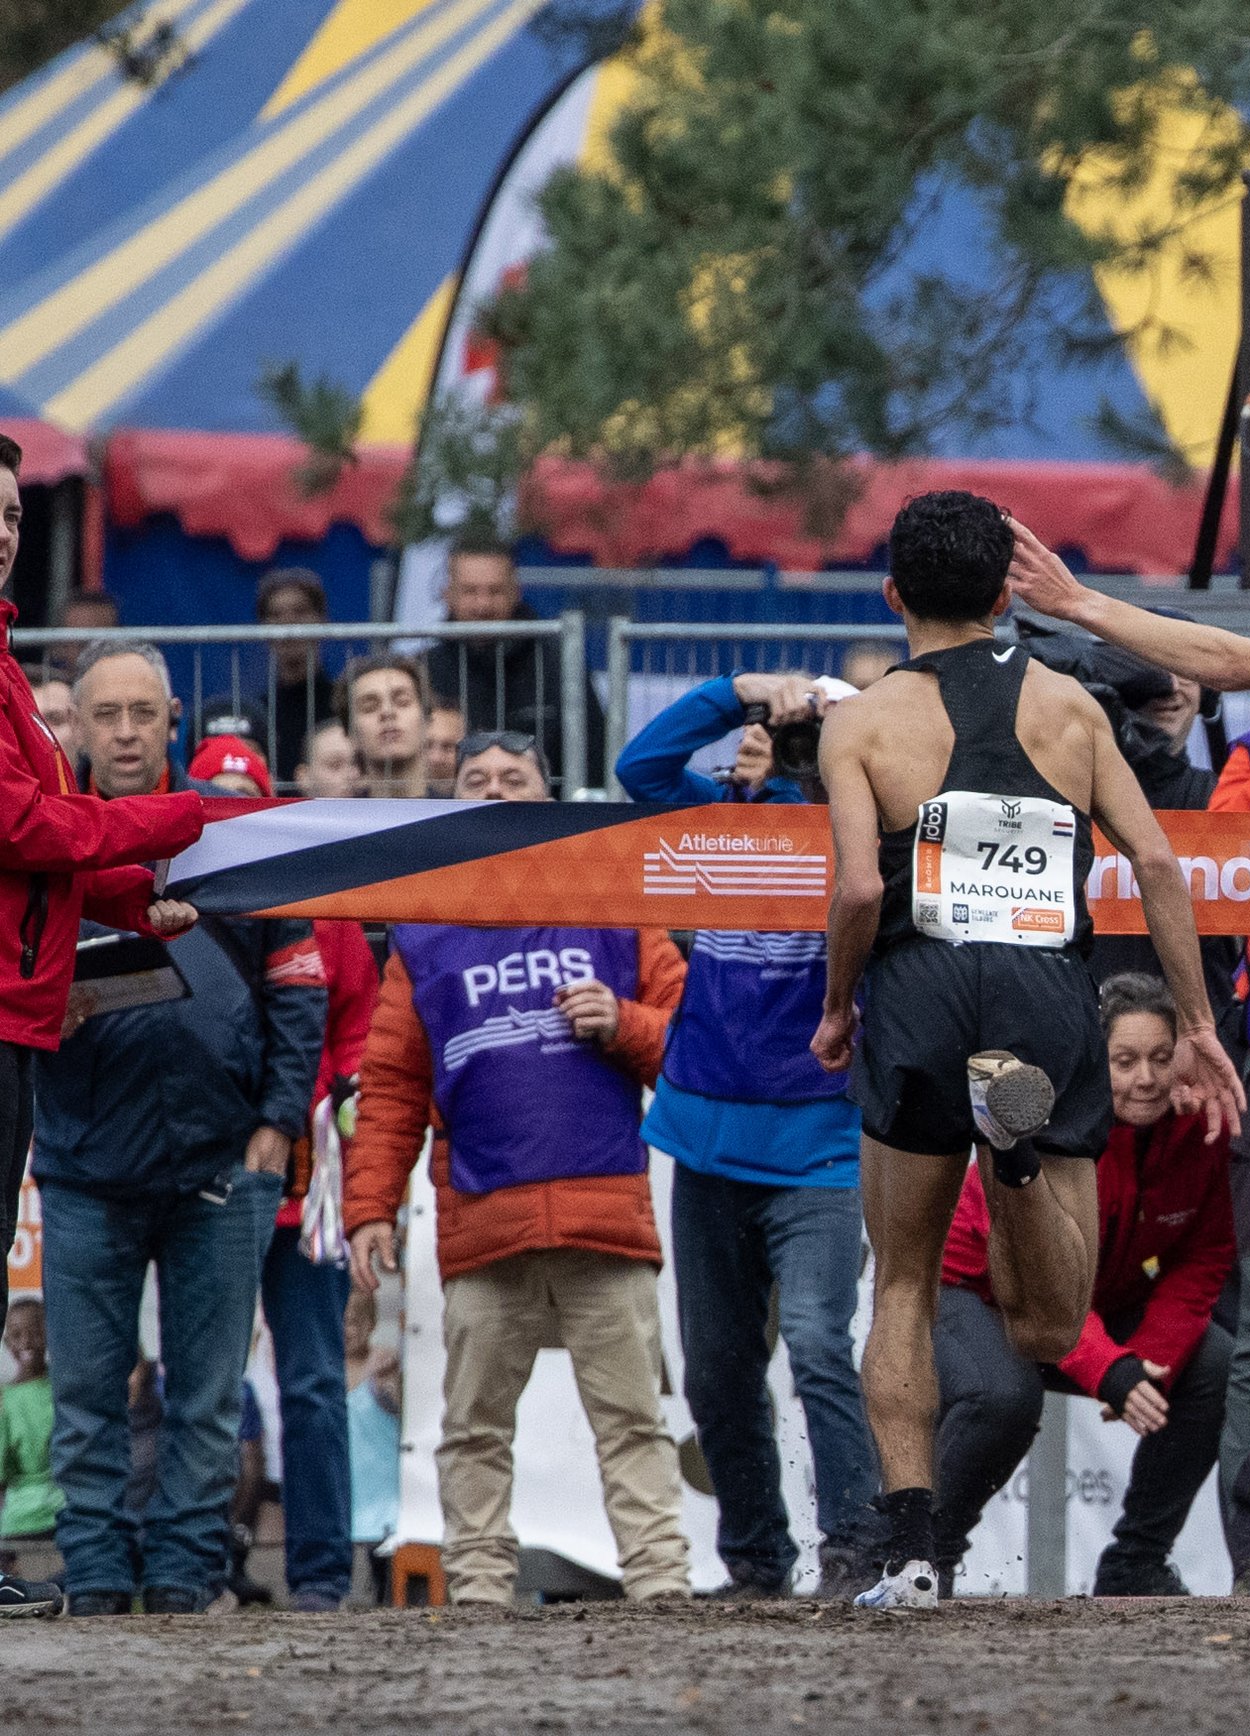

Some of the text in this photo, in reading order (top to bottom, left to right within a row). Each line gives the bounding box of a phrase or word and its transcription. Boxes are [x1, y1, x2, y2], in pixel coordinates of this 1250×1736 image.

[923, 803, 943, 842] capi
[998, 820, 1023, 829] TRIBE
[678, 833, 793, 852] Atletiekunie
[977, 841, 1048, 875] 749
[950, 881, 1066, 903] MAROUANE
[1020, 913, 1059, 925] NK Cross
[463, 947, 596, 1007] PERS
